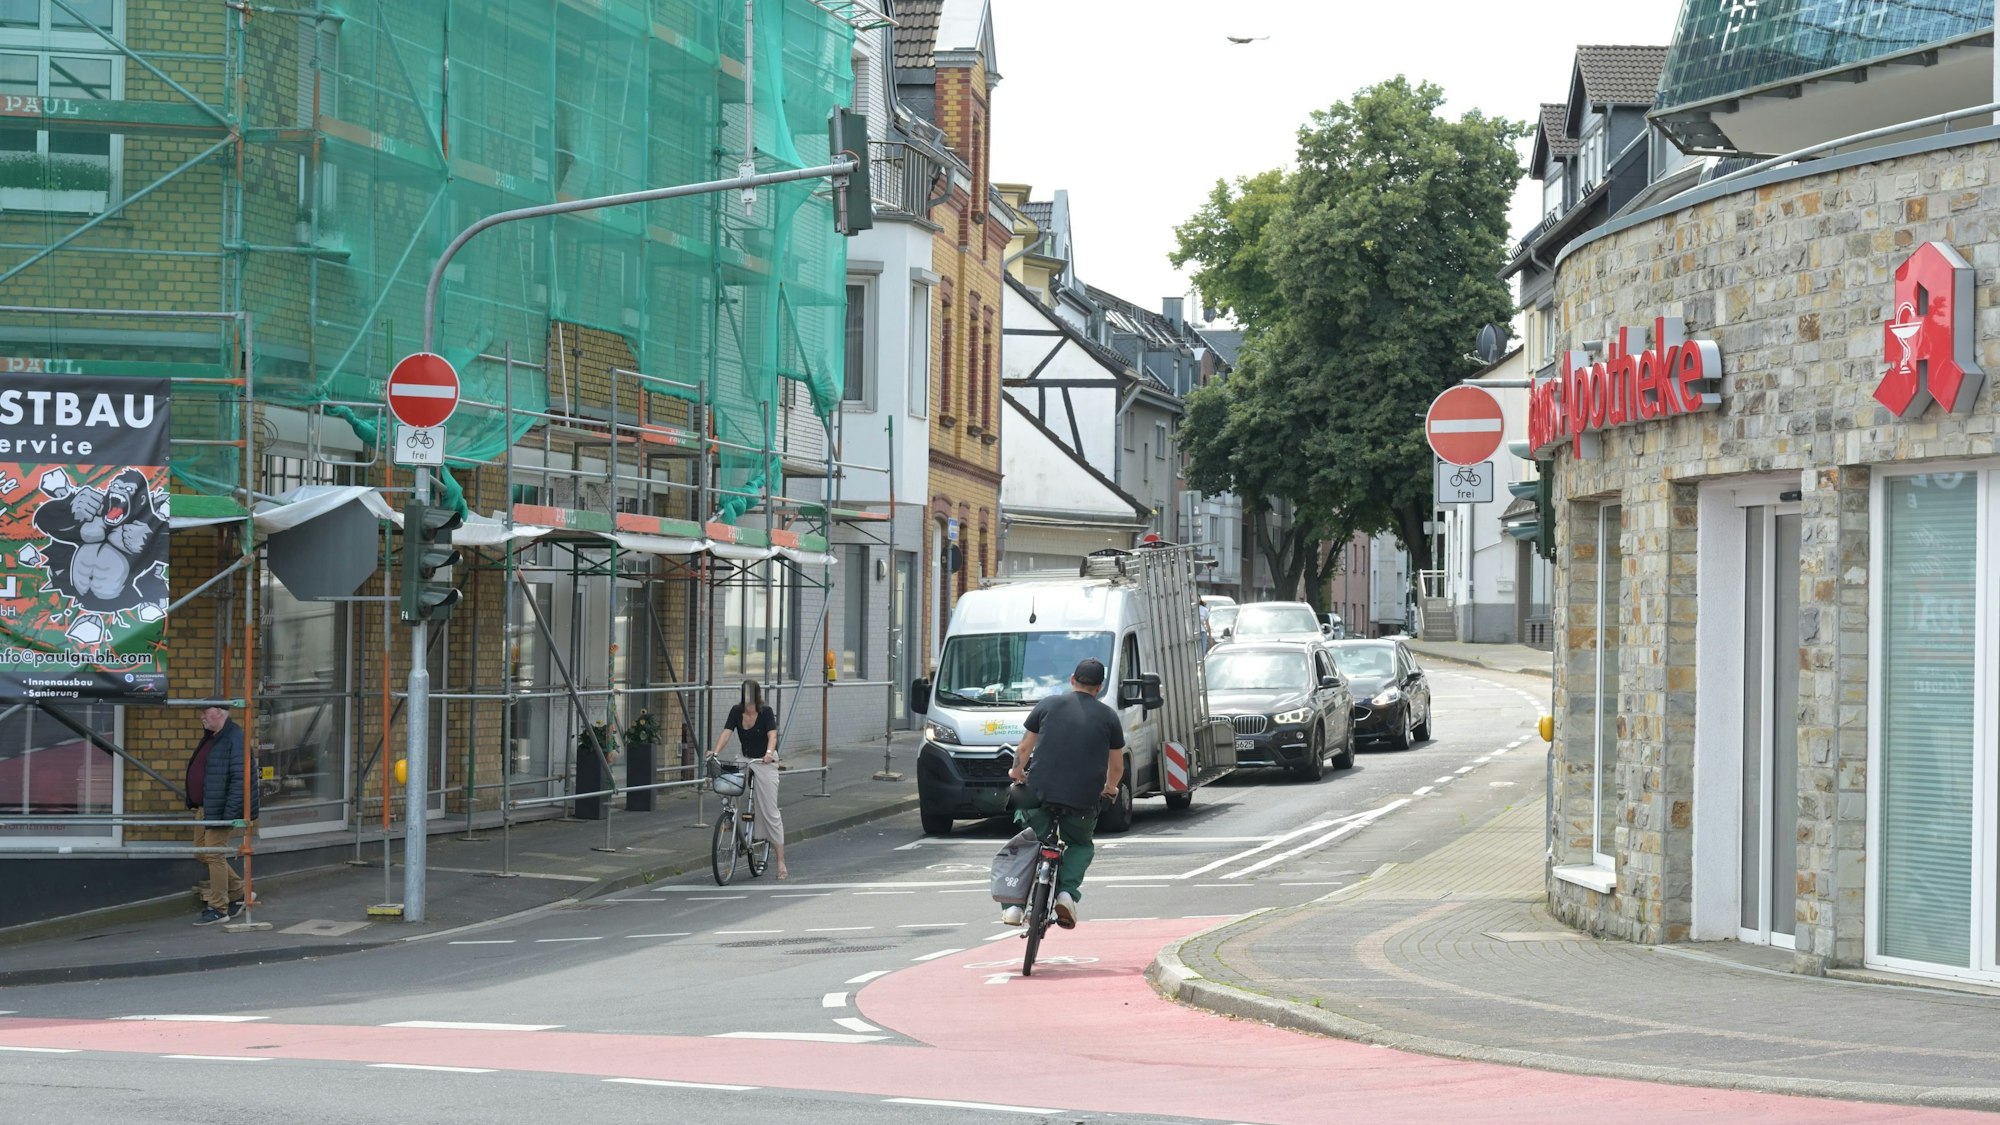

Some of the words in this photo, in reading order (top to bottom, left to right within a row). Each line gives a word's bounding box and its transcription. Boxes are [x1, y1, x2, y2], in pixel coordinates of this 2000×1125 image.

[5, 96, 79, 115] PAUL
[7, 358, 82, 375] PAUL
[1560, 316, 1704, 460] Apotheke
[412, 450, 428, 460] frei
[1457, 489, 1475, 499] frei
[556, 508, 577, 525] PAUL
[728, 525, 744, 541] PAUL
[28, 677, 93, 687] Innenausbau
[28, 689, 79, 698] Sanierung
